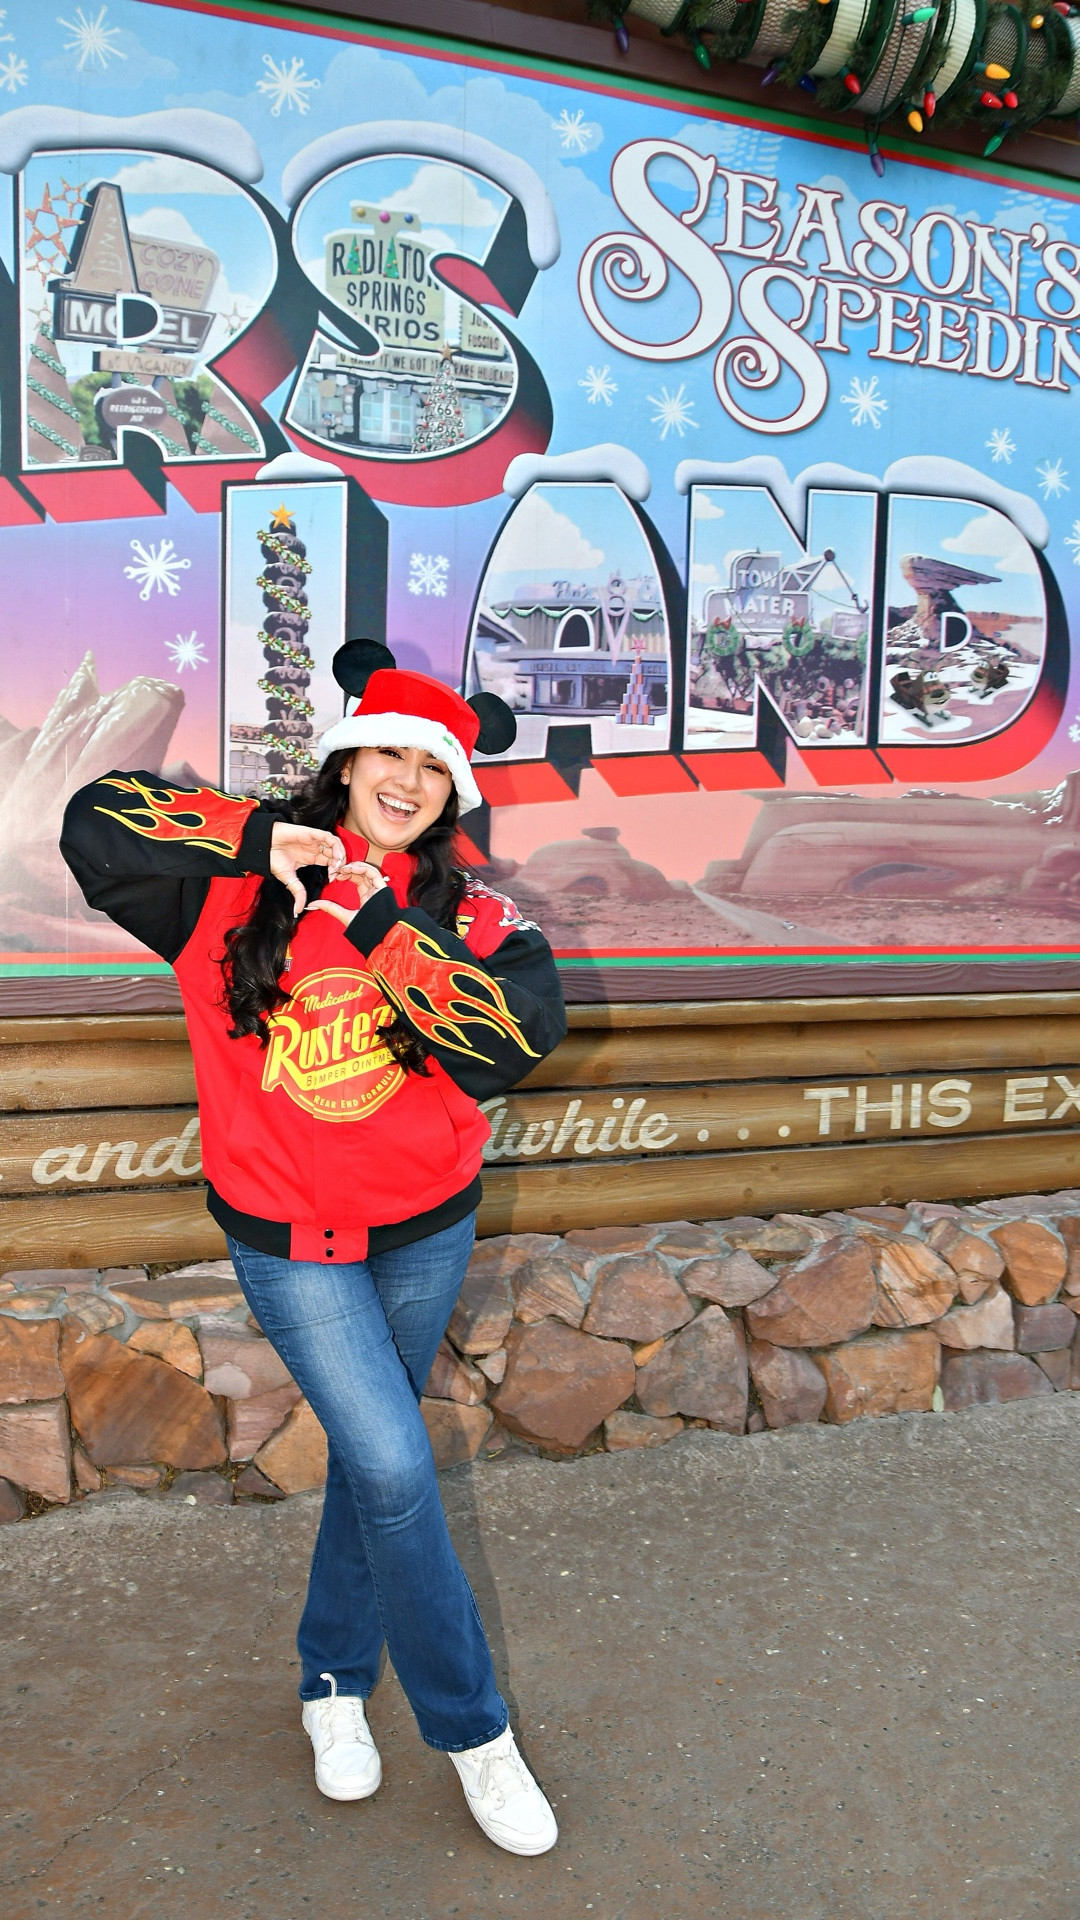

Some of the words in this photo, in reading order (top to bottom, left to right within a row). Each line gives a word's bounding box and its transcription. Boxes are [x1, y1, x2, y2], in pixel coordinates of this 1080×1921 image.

[140, 244, 206, 274] COZY
[578, 137, 1080, 361] SEASON'S
[140, 270, 207, 299] CONE
[346, 281, 426, 316] SPRINGS
[69, 301, 200, 346] MOEL
[737, 569, 780, 589] TOW
[722, 594, 796, 617] MATER
[300, 983, 364, 1015] Medicated
[352, 1051, 391, 1073] OINTME
[313, 1094, 337, 1109] REAR
[340, 1098, 359, 1109] END
[360, 1069, 396, 1104] FORMULA
[32, 1116, 202, 1185] and
[803, 1078, 973, 1135] THIS
